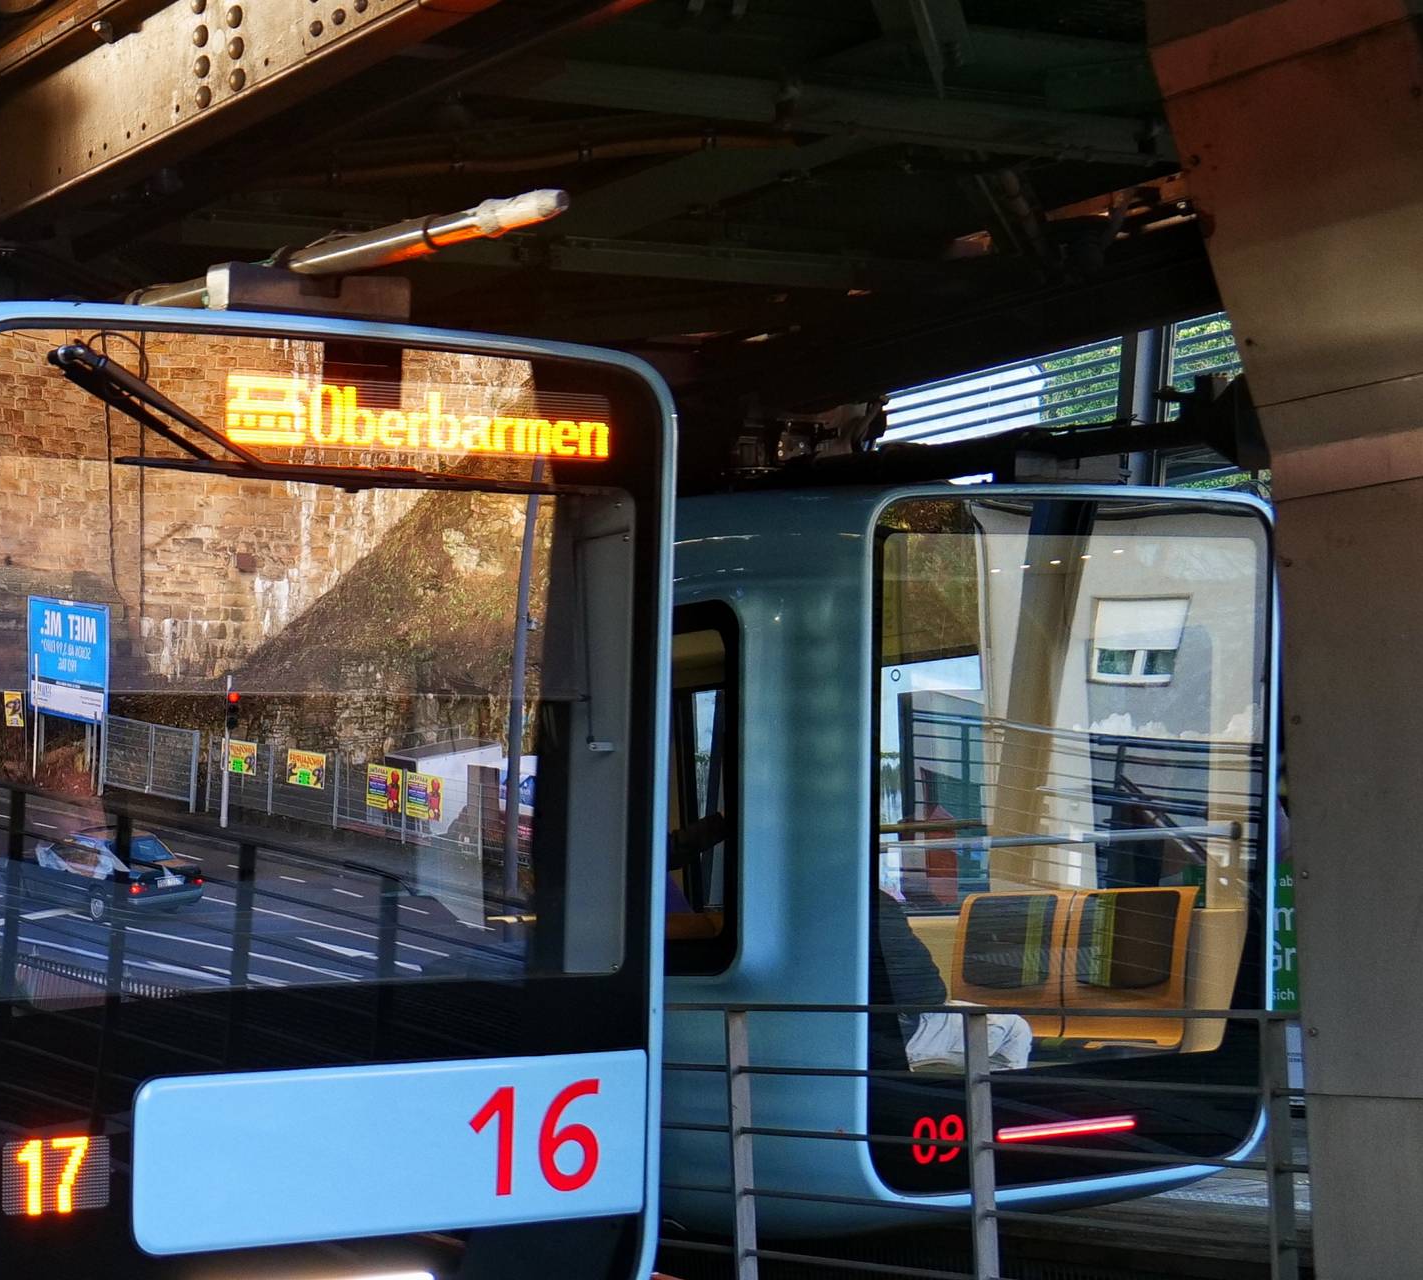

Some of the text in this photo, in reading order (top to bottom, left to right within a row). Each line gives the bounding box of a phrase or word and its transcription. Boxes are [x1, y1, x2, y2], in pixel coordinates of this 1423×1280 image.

[310, 384, 609, 458] Oberbarmen
[15, 1136, 90, 1216] 17
[468, 1078, 600, 1197] 16
[912, 1114, 965, 1164] 09
